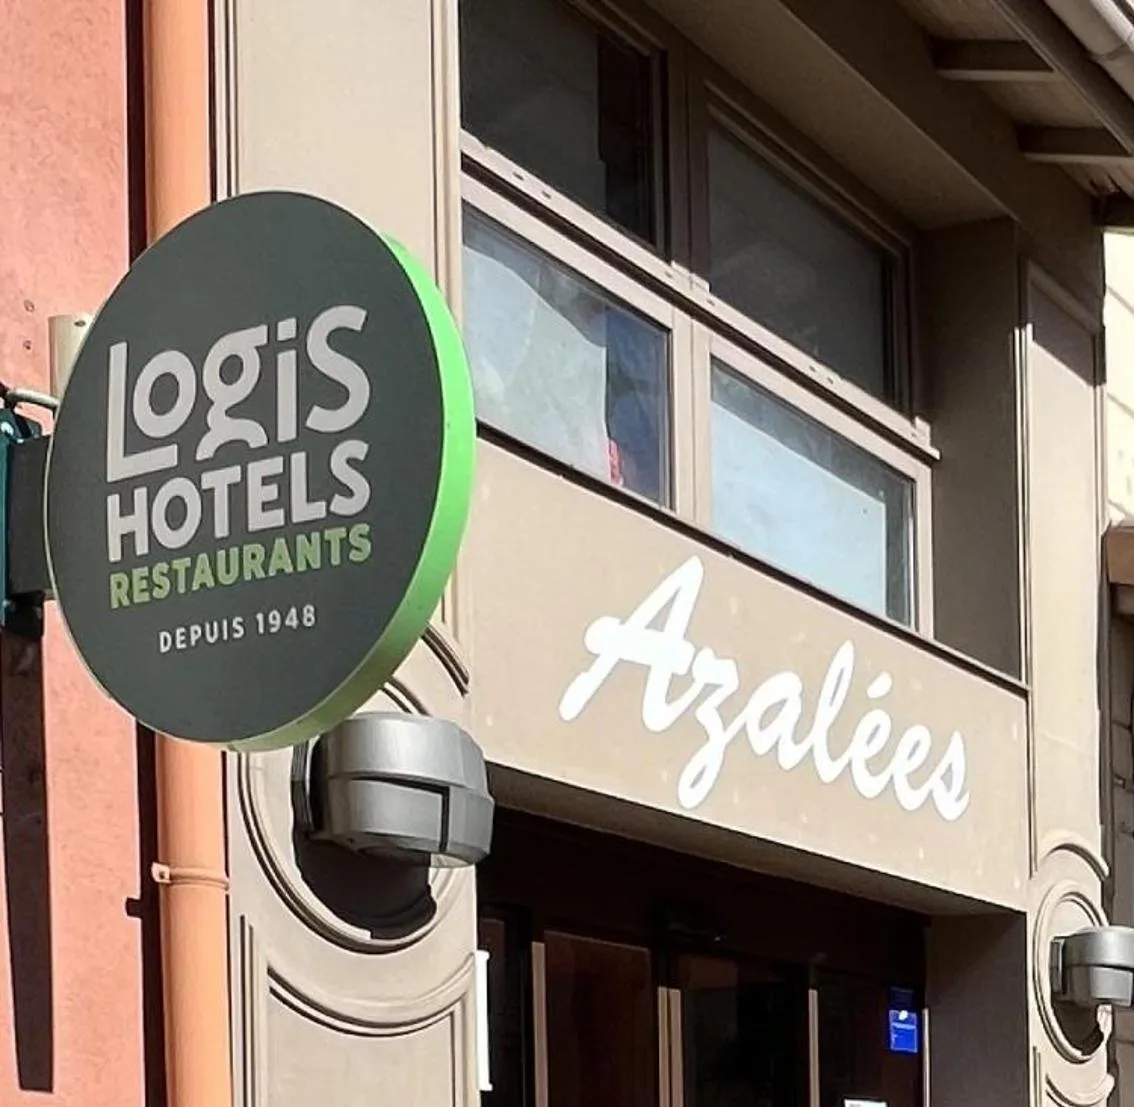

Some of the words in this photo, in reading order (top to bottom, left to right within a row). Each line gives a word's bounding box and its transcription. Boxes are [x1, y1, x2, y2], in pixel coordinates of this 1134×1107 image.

[106, 439, 372, 563] HOTELS
[109, 523, 373, 609] RESTAURANTS
[158, 615, 246, 654] DEPUIS
[256, 604, 318, 636] 1948
[558, 555, 970, 821] Azalées
